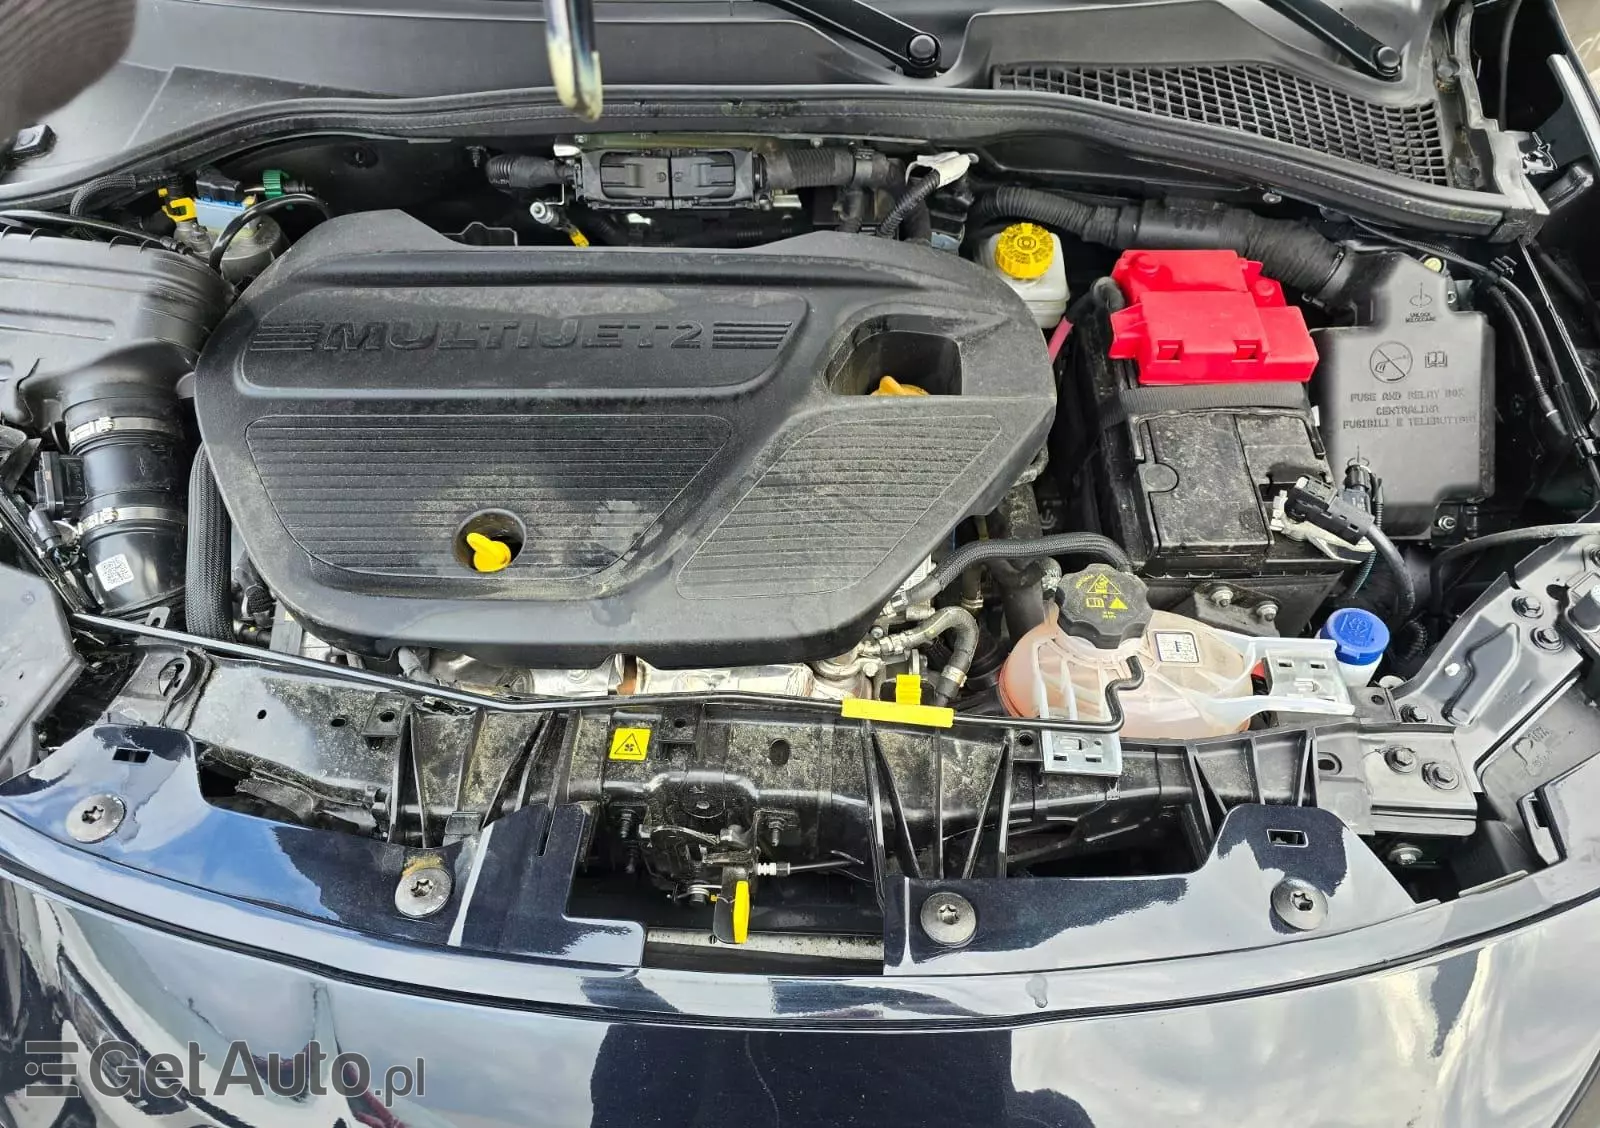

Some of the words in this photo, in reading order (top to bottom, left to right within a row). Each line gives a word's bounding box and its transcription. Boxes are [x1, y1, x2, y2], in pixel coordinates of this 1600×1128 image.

[1350, 392, 1377, 402] FUSE
[1382, 391, 1402, 401] AND
[1407, 389, 1440, 400] RELAY
[1444, 387, 1466, 399] BOX
